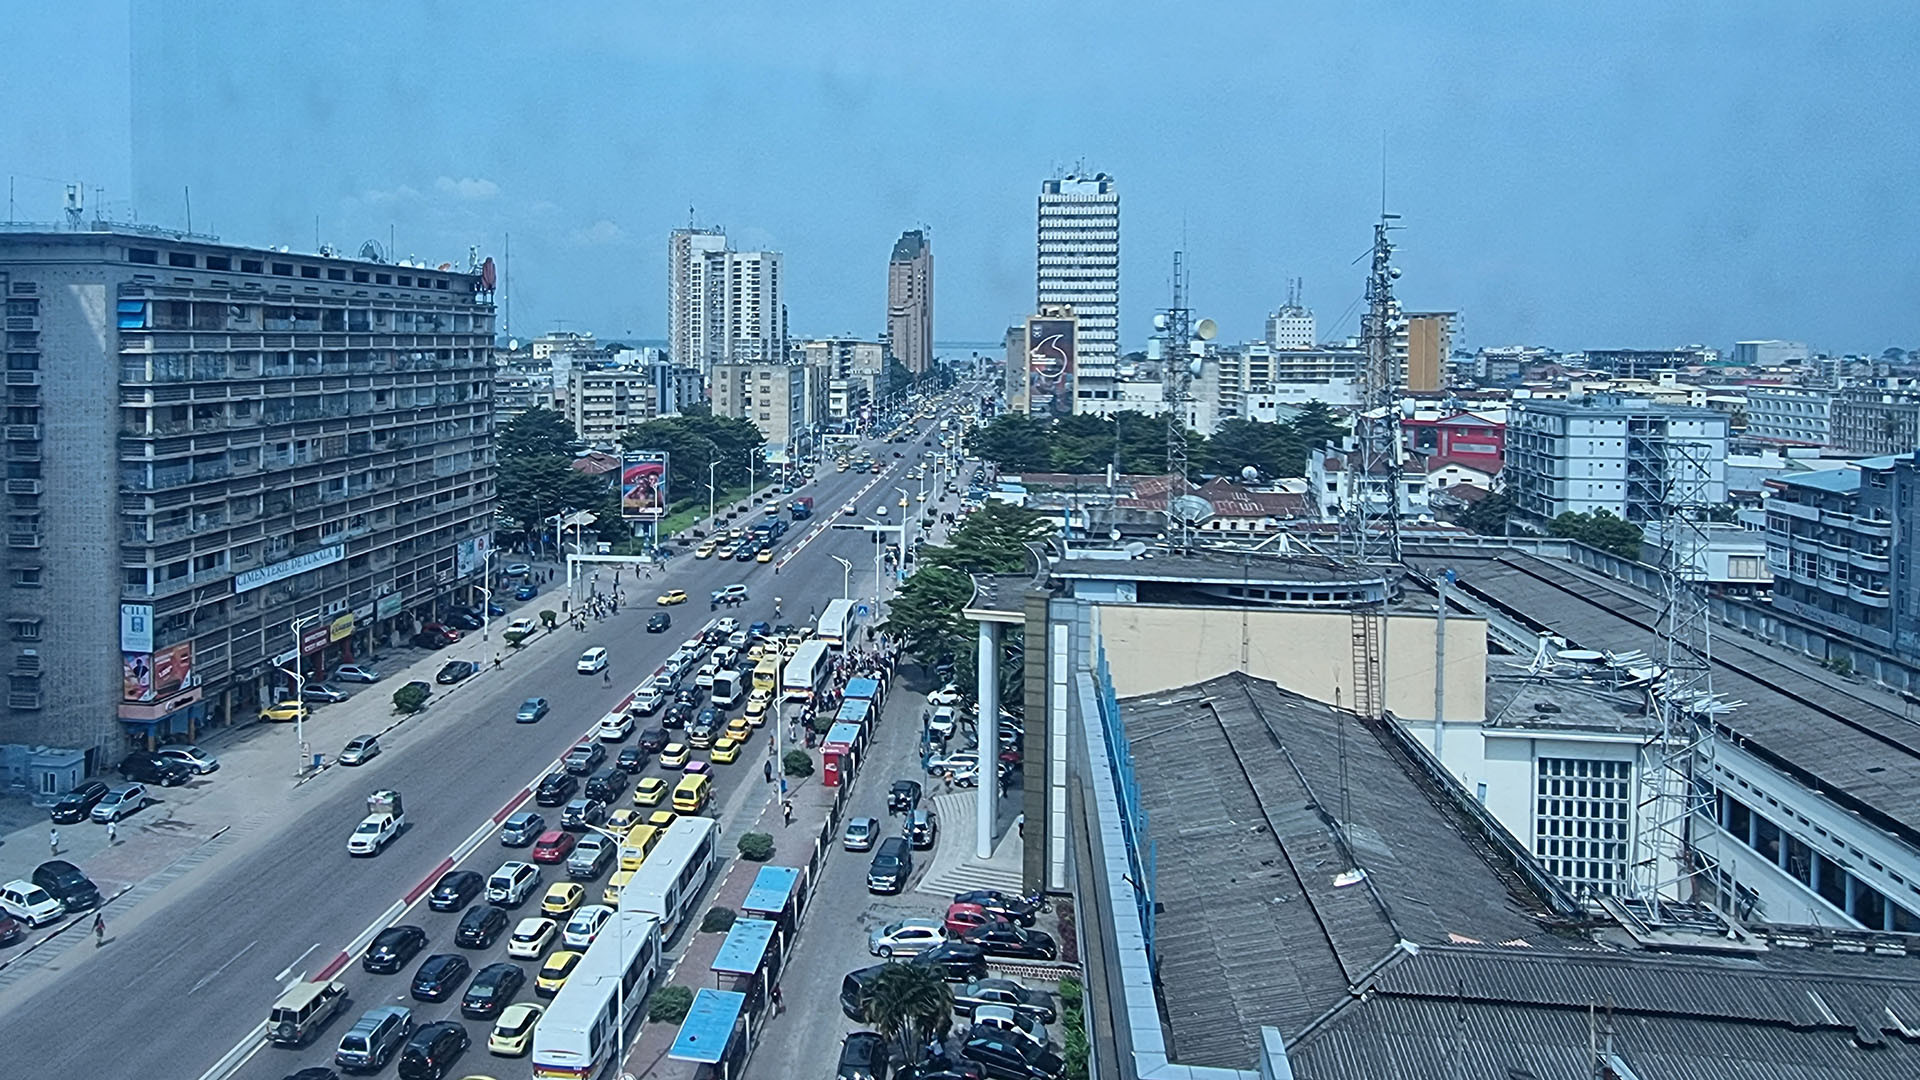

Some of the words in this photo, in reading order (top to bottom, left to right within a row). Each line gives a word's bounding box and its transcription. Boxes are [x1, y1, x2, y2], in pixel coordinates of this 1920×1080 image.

[237, 563, 290, 586] CIMENTERIE
[291, 558, 301, 570] DE
[122, 606, 150, 616] CILU
